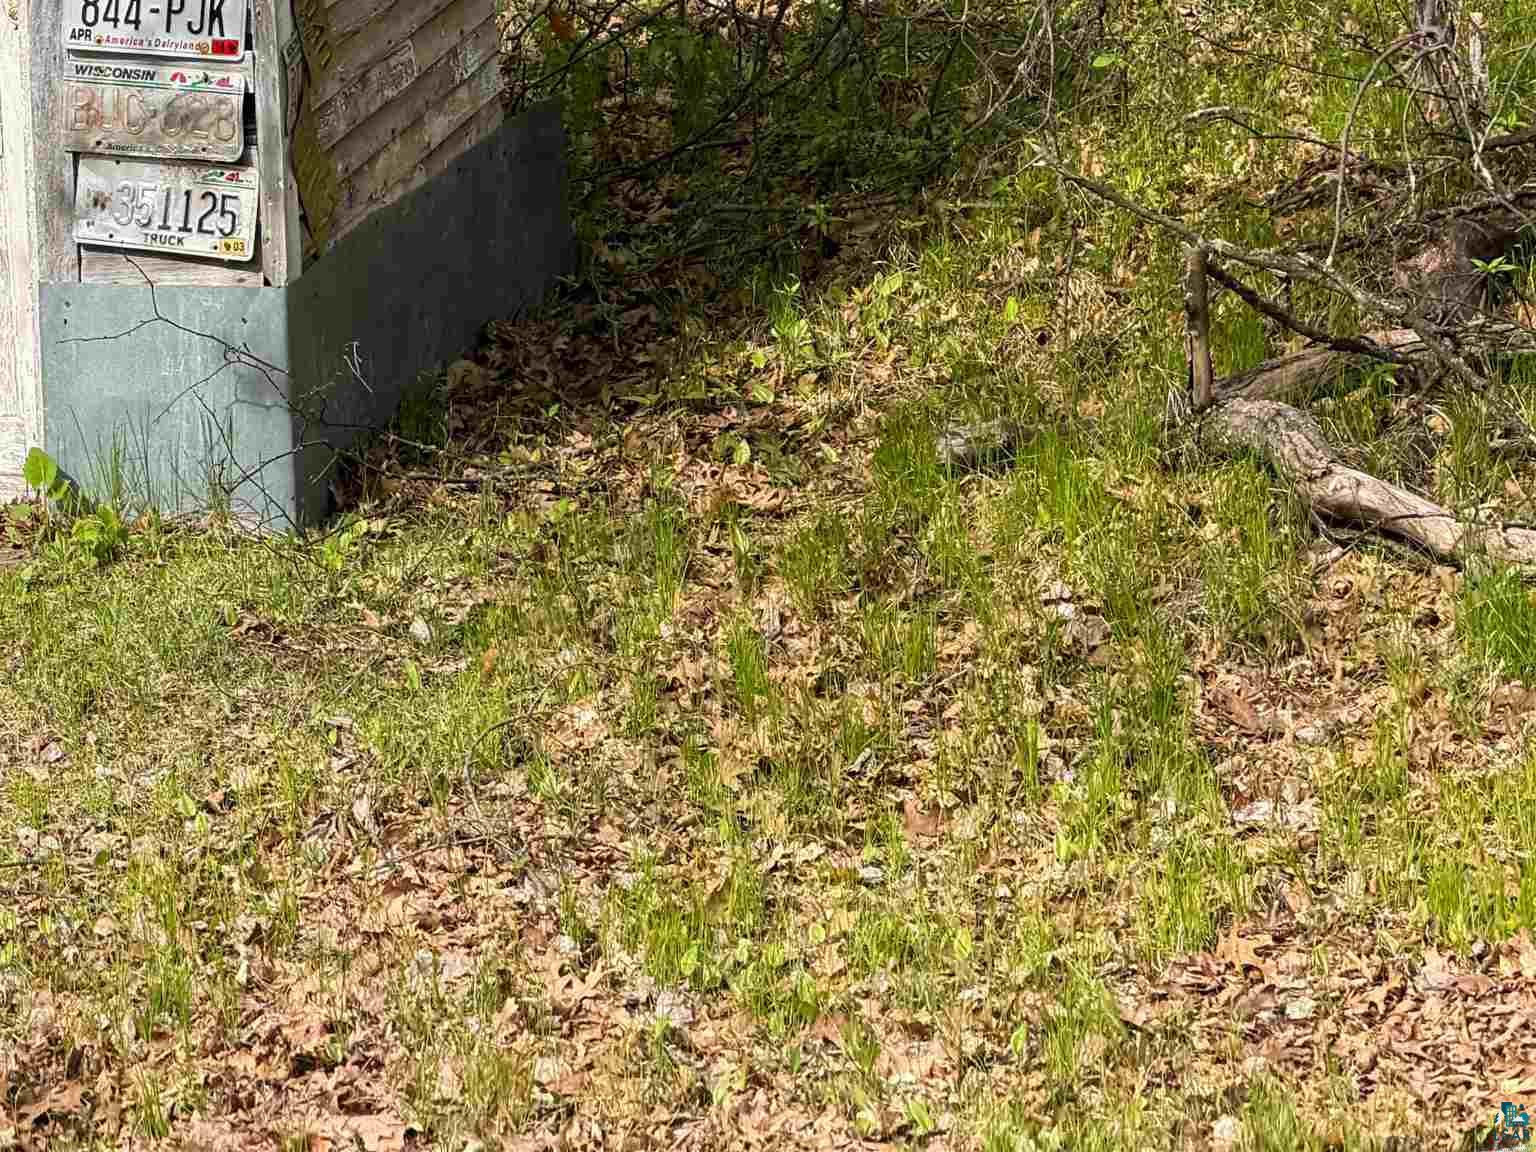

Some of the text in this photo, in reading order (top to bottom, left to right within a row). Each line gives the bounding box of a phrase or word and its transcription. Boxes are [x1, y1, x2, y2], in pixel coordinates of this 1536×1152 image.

[69, 28, 92, 41] APR
[105, 35, 151, 47] America's
[75, 64, 156, 81] WISCONSIN
[114, 180, 240, 237] 351125
[144, 233, 184, 246] TRUCK
